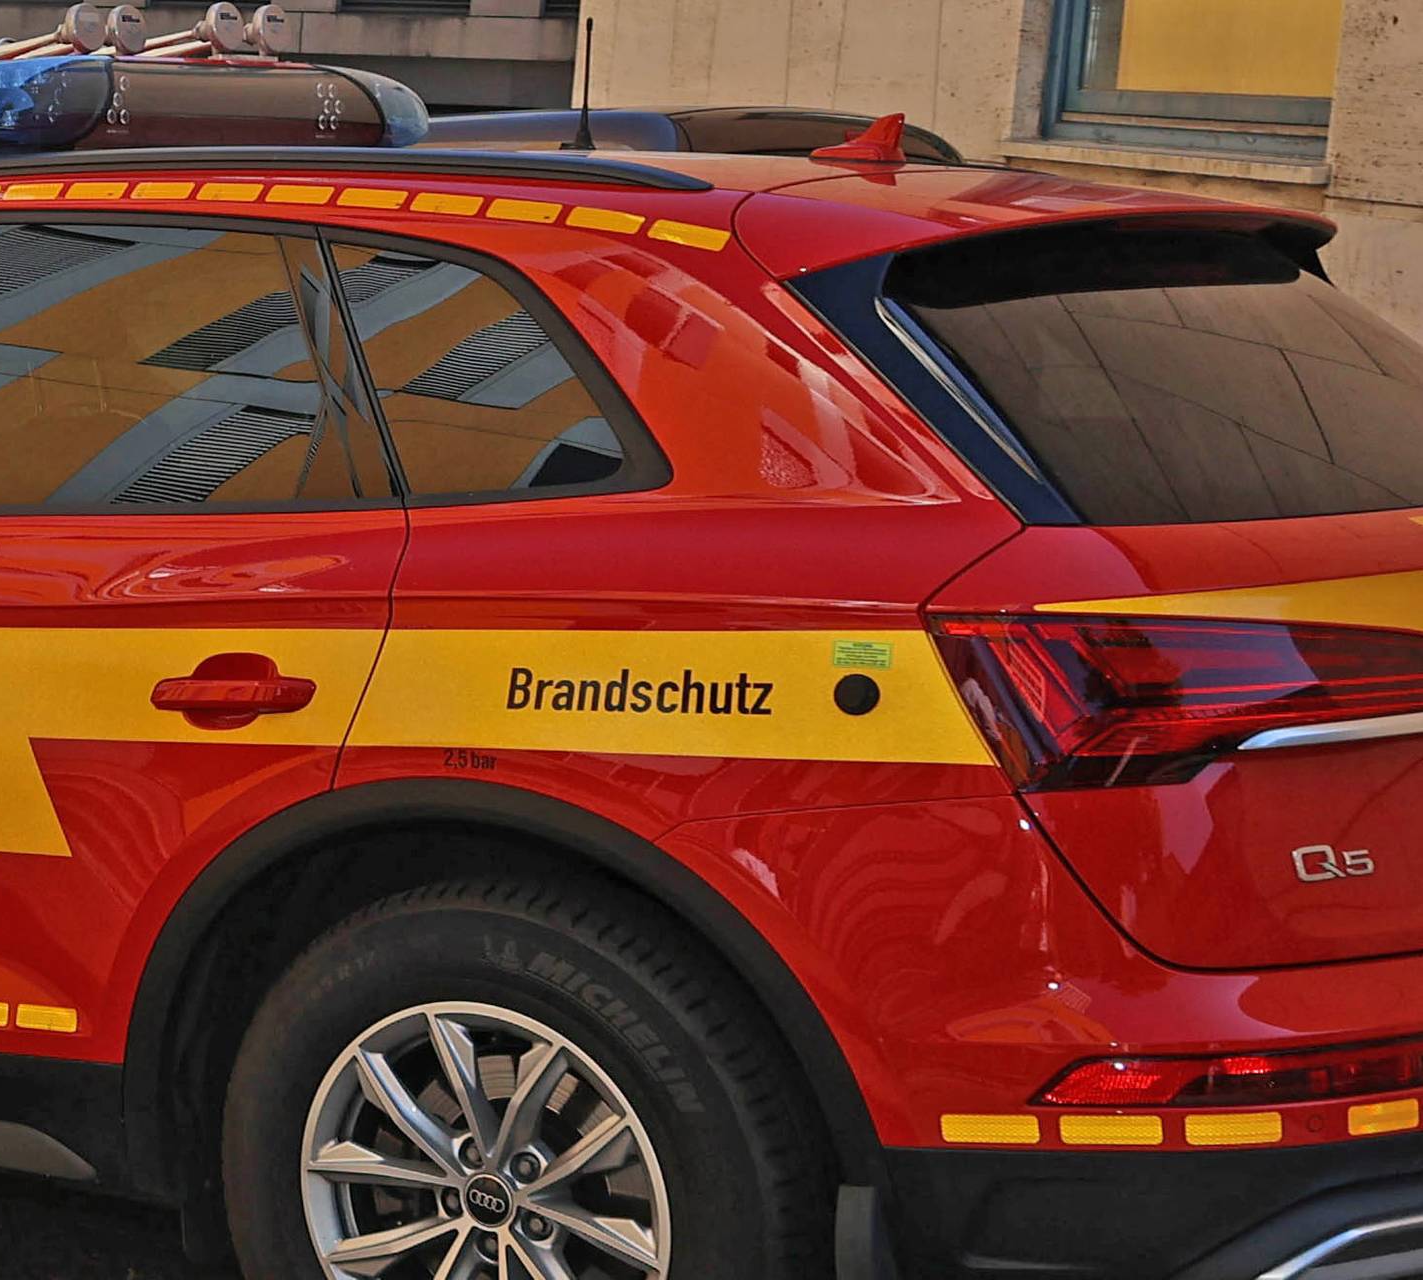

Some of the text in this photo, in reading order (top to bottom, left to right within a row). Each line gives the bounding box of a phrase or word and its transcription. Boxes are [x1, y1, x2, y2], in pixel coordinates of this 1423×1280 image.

[506, 667, 774, 715] Brandschutz
[470, 751, 498, 770] bar
[1292, 844, 1375, 882] Q5
[527, 951, 706, 1112] MICHELIN
